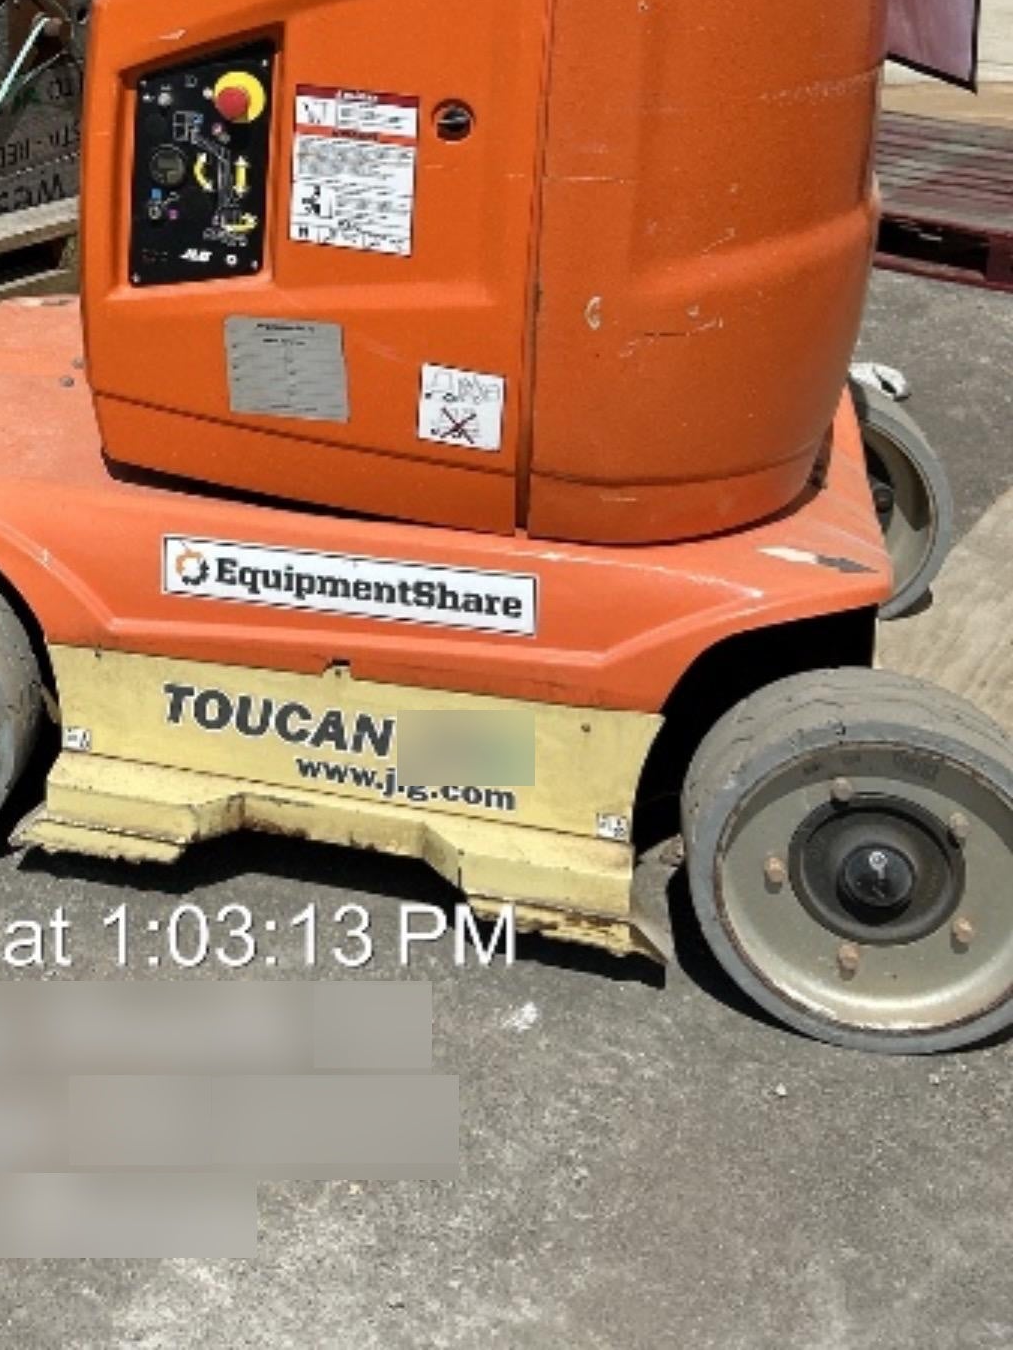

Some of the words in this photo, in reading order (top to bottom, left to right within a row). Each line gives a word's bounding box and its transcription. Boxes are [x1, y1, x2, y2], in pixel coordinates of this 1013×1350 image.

[215, 557, 523, 618] EquipmentShare
[164, 683, 396, 756] TOUCAN
[296, 758, 515, 810] www.jg.com
